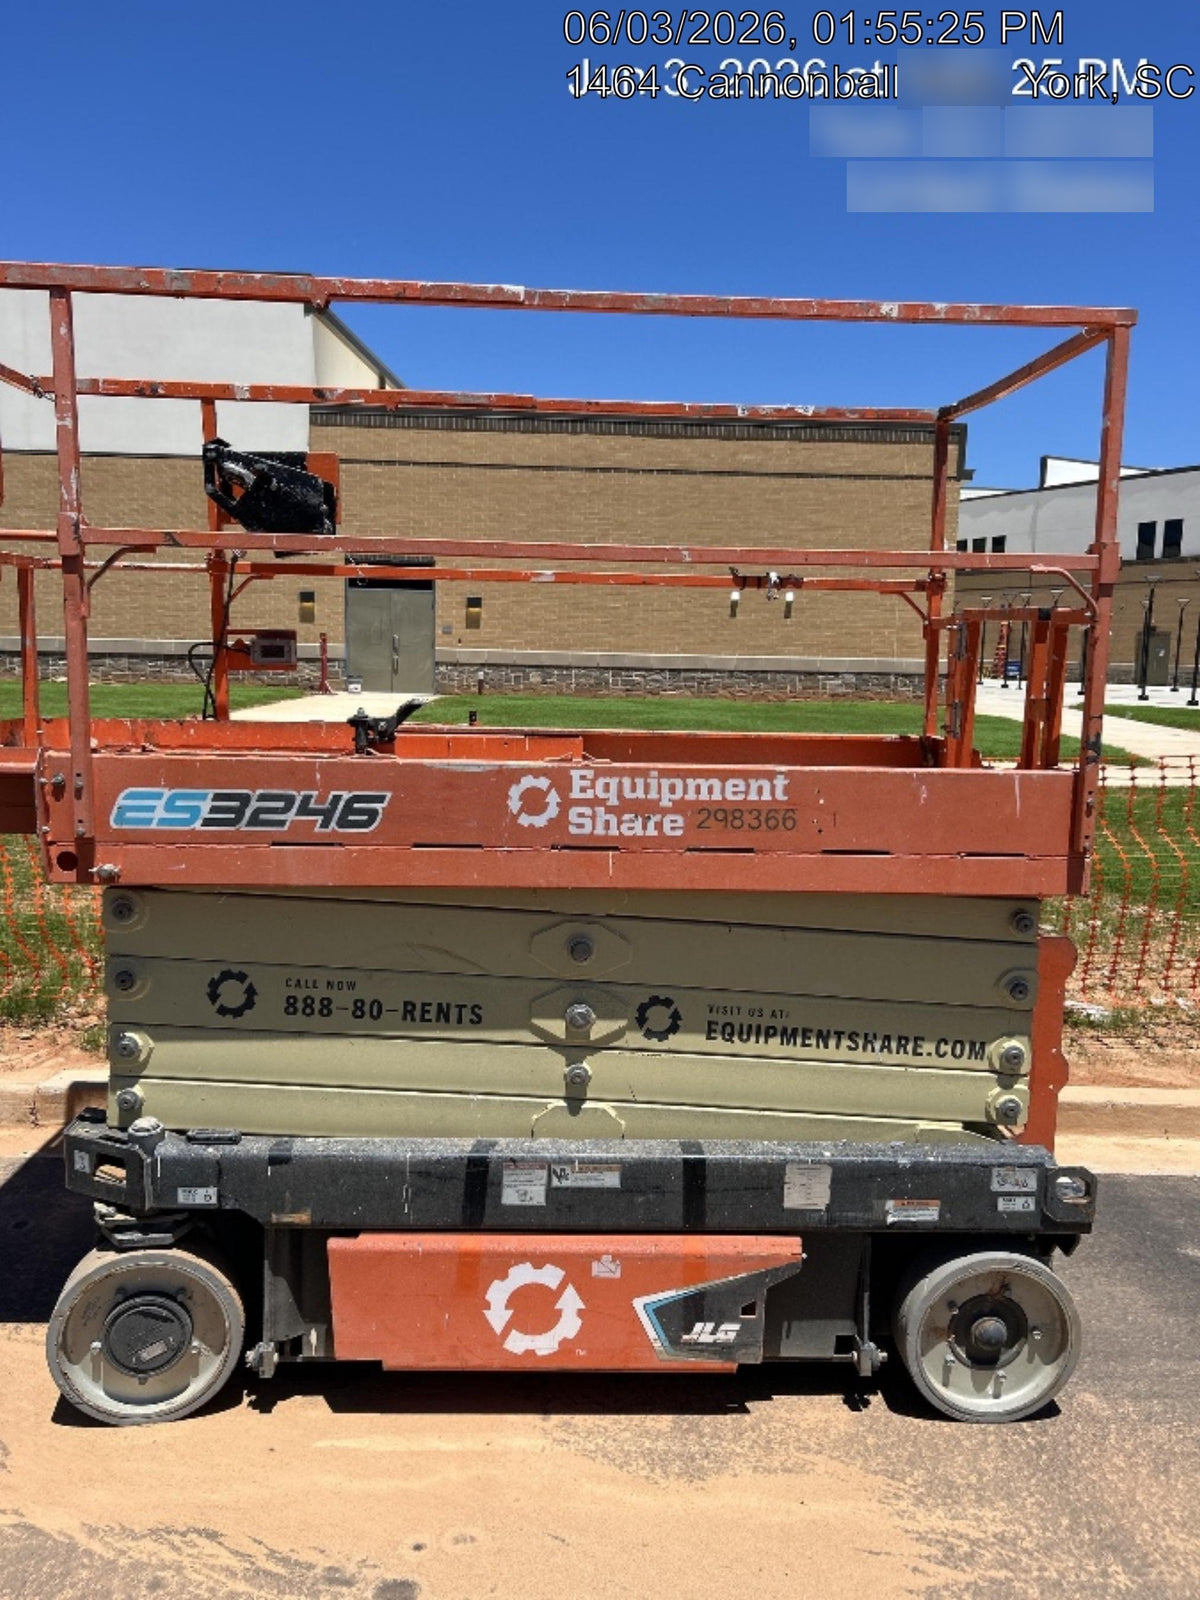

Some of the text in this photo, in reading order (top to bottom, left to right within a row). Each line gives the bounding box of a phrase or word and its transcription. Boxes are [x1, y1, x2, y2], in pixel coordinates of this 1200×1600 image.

[569, 769, 790, 807] Equipment
[110, 787, 392, 832] ES3246
[568, 806, 798, 836] Share 298366
[285, 977, 357, 991] CALL NOW
[283, 995, 483, 1025] 888-80-RENTS
[707, 1003, 742, 1016] VISIT
[747, 1007, 764, 1018] US
[705, 1019, 987, 1061] EQUIPMENTSHARE.COM
[680, 1322, 742, 1343] JLG
